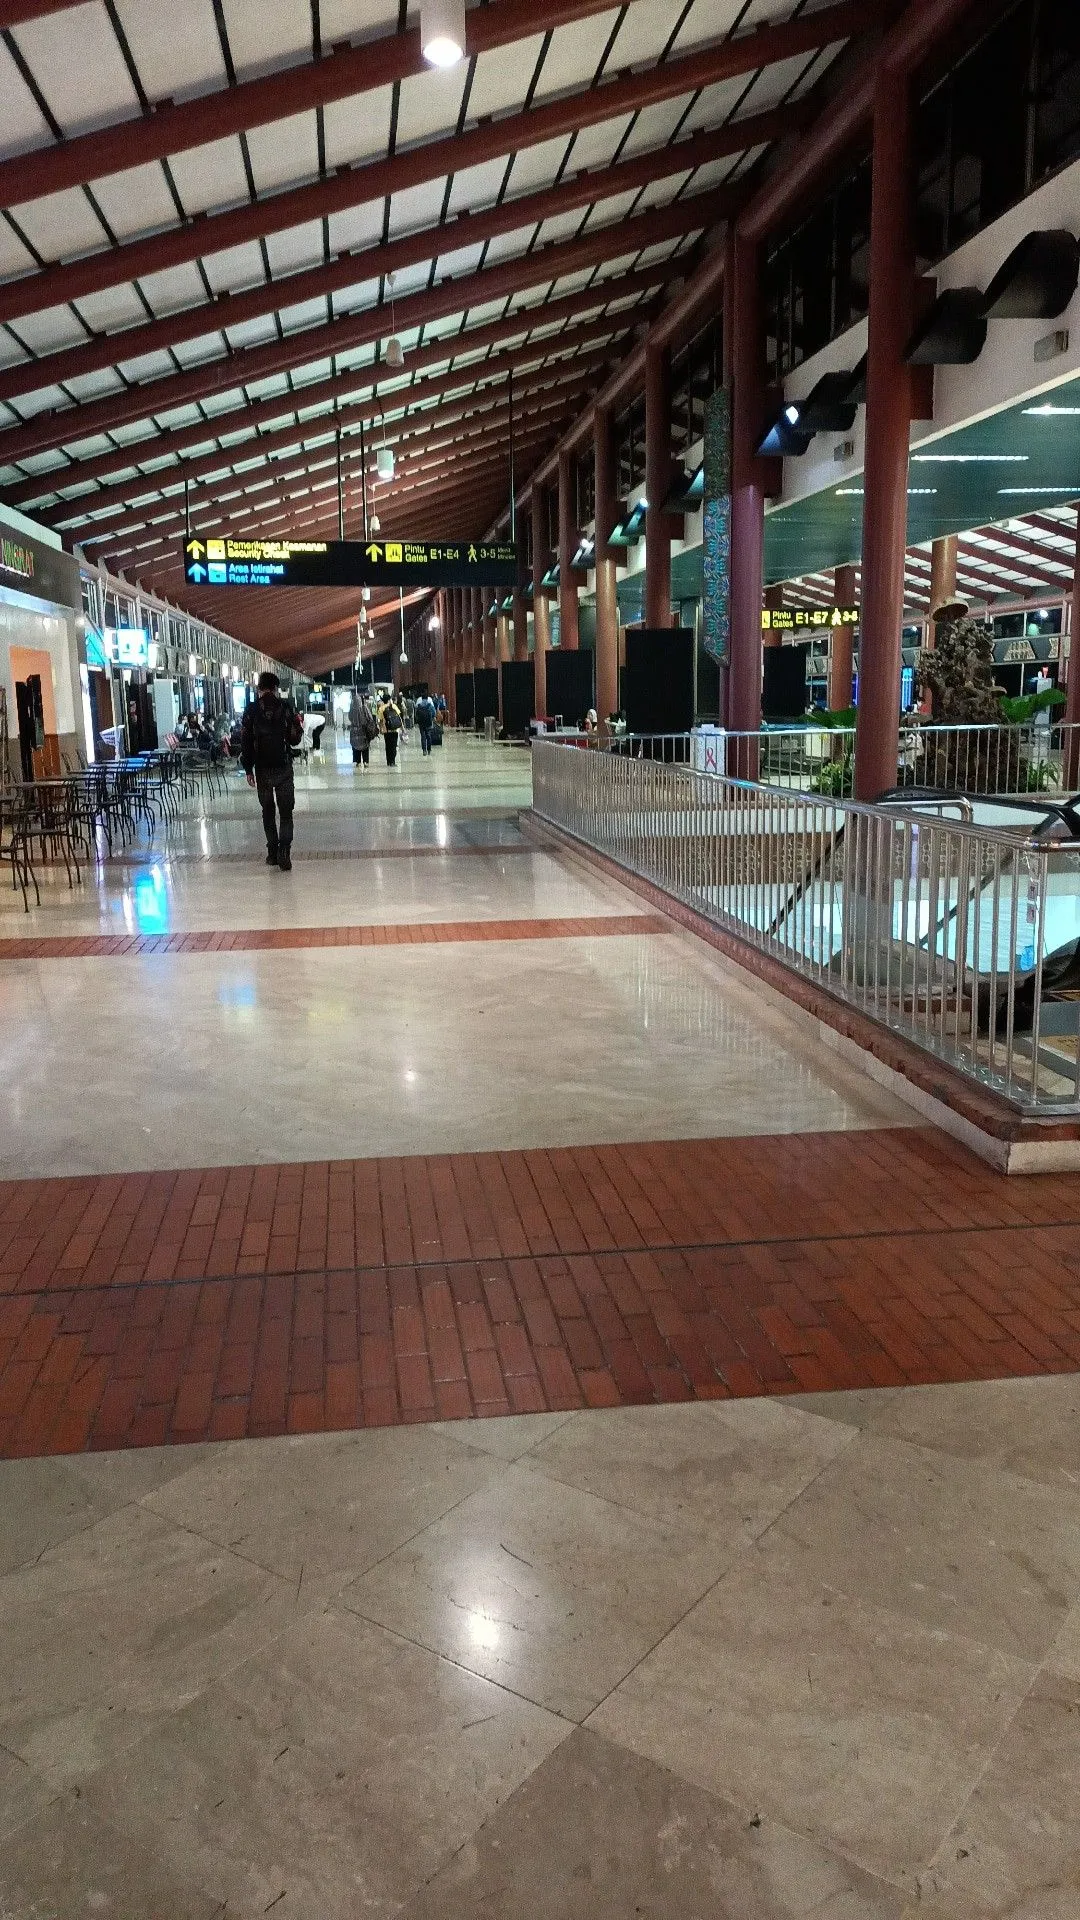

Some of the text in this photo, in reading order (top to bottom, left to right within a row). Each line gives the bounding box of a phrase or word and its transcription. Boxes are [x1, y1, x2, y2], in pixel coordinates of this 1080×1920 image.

[405, 544, 425, 553] Pintu
[405, 553, 428, 563] Gates
[430, 548, 496, 559] E1-E4 3-5
[229, 564, 249, 573] Area
[229, 574, 270, 584] Rest Area
[773, 611, 791, 620] Pintu
[796, 611, 828, 624] E1-E7
[773, 620, 793, 628] Gates
